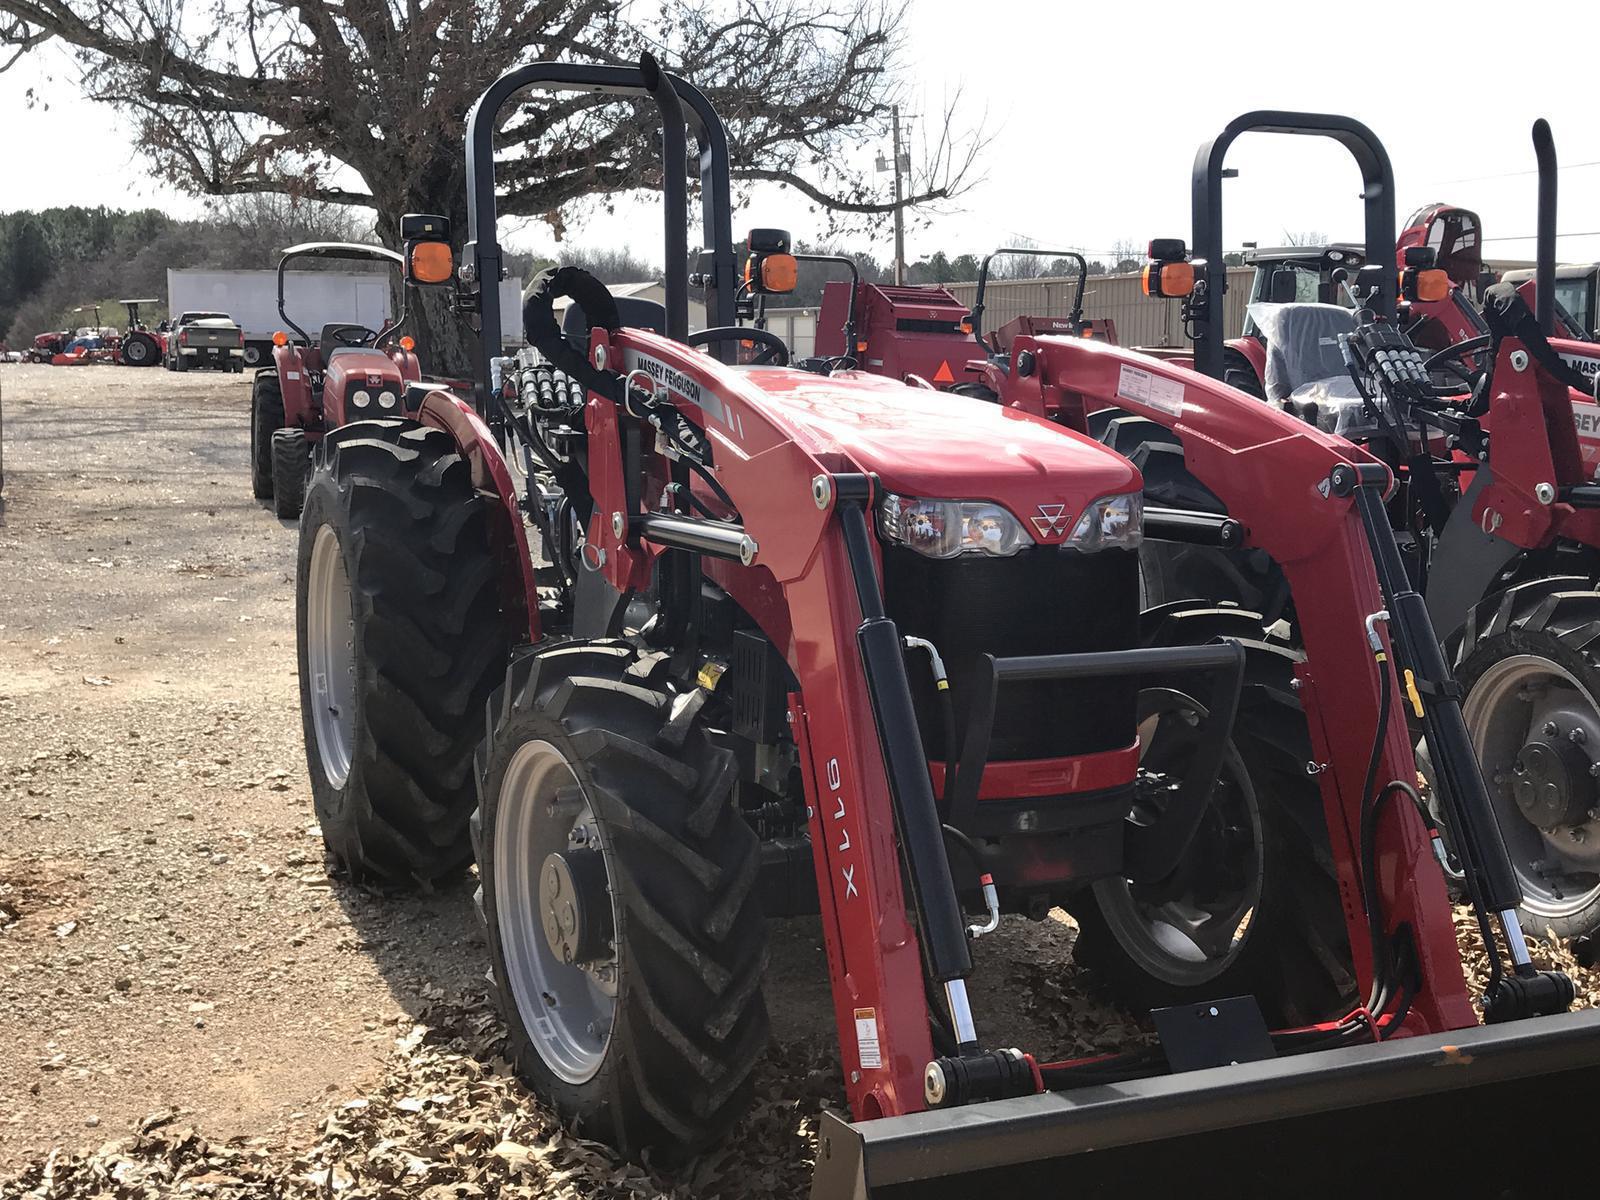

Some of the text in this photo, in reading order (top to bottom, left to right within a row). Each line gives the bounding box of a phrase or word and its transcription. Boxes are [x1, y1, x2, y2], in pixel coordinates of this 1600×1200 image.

[637, 357, 701, 402] MASSEY FERGUSON
[1571, 359, 1600, 374] MAS
[826, 757, 859, 900] 911X
